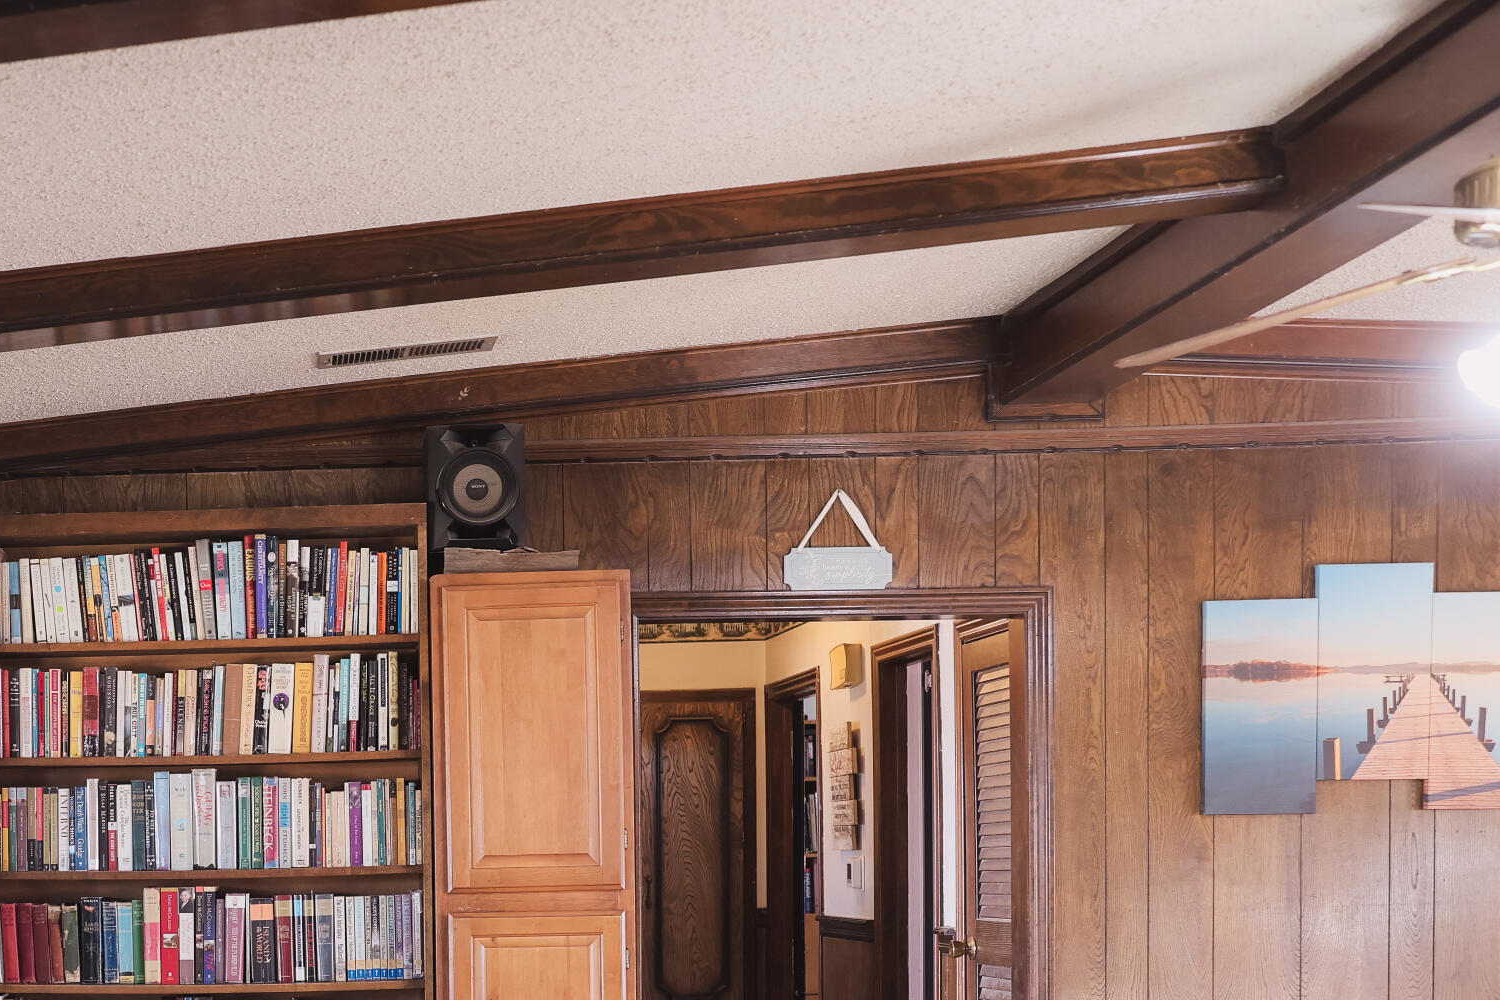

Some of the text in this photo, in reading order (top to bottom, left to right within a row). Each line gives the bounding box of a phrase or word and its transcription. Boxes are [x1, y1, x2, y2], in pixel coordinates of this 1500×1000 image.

[245, 549, 255, 581] EXODUS
[77, 791, 85, 801] The
[204, 792, 213, 826] GULAG
[60, 794, 69, 839] INFERNO
[263, 783, 274, 852] STEINBECK
[76, 838, 85, 859] Goudge
[262, 926, 271, 957] ISLAND
[206, 953, 214, 971] 1776
